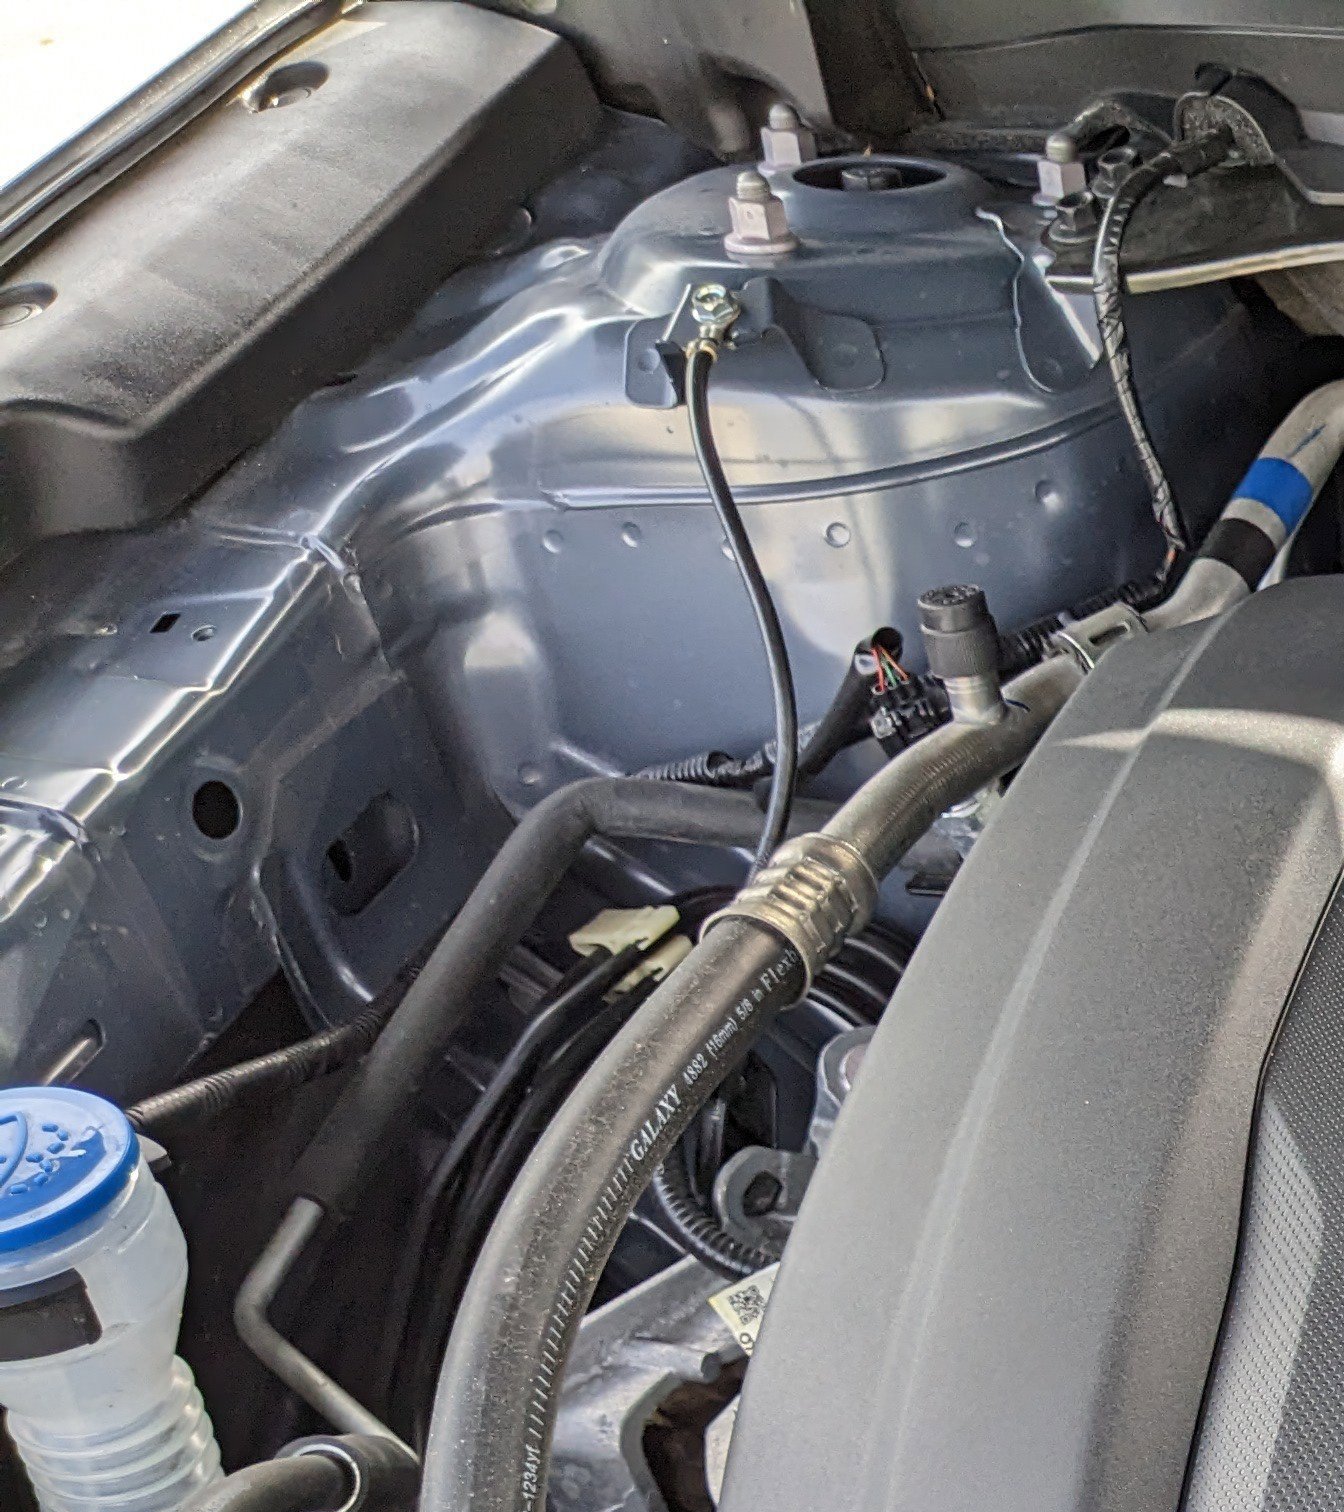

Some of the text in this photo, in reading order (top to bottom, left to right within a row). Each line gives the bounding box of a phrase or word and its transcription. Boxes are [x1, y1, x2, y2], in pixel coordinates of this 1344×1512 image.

[629, 1084, 682, 1162] GALAXY
[682, 1053, 709, 1089] 4882
[704, 1018, 740, 1060] (16mm)
[734, 998, 755, 1022] 5/8
